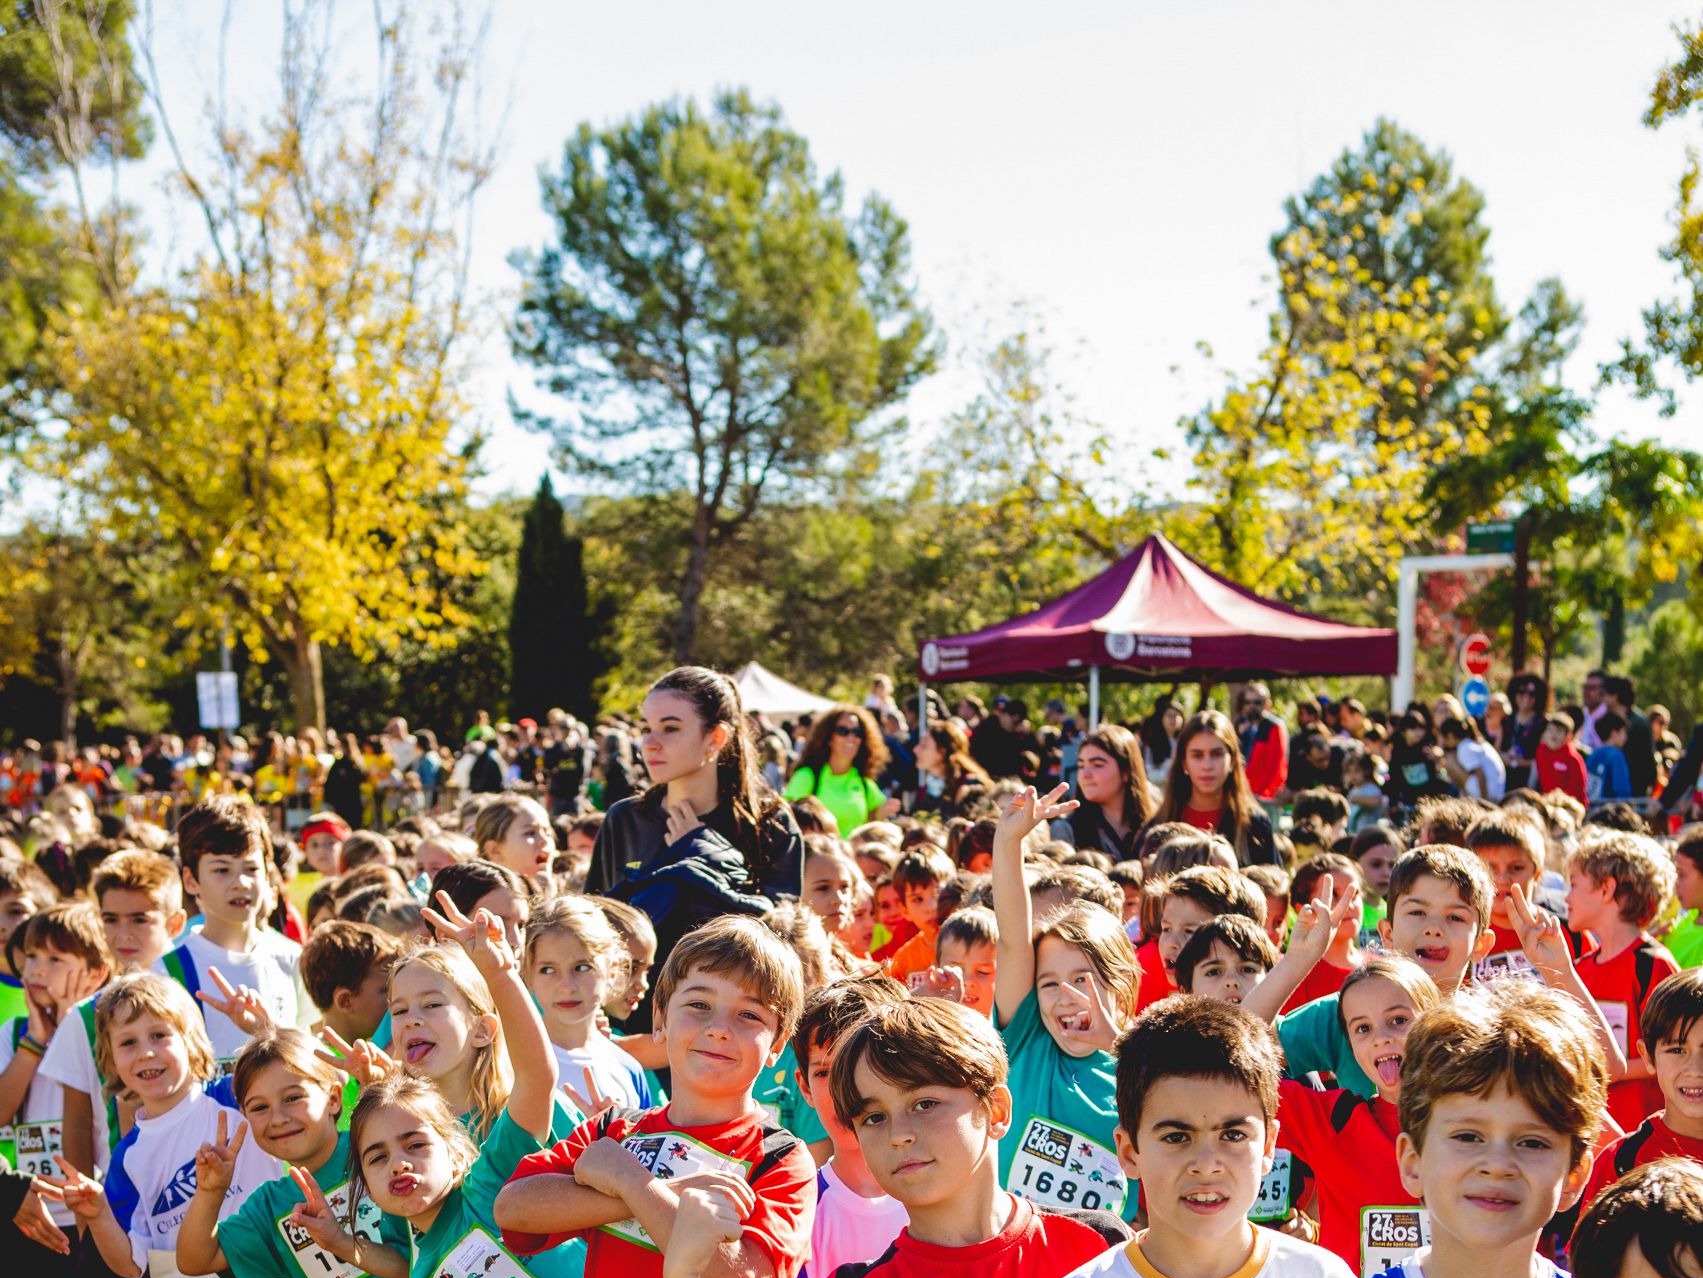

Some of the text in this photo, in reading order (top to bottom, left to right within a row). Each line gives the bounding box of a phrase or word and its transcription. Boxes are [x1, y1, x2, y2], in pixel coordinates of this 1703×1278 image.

[1027, 1135, 1067, 1160] CROS
[1022, 1164, 1101, 1210] 1680
[1370, 1225, 1419, 1243] CROS
